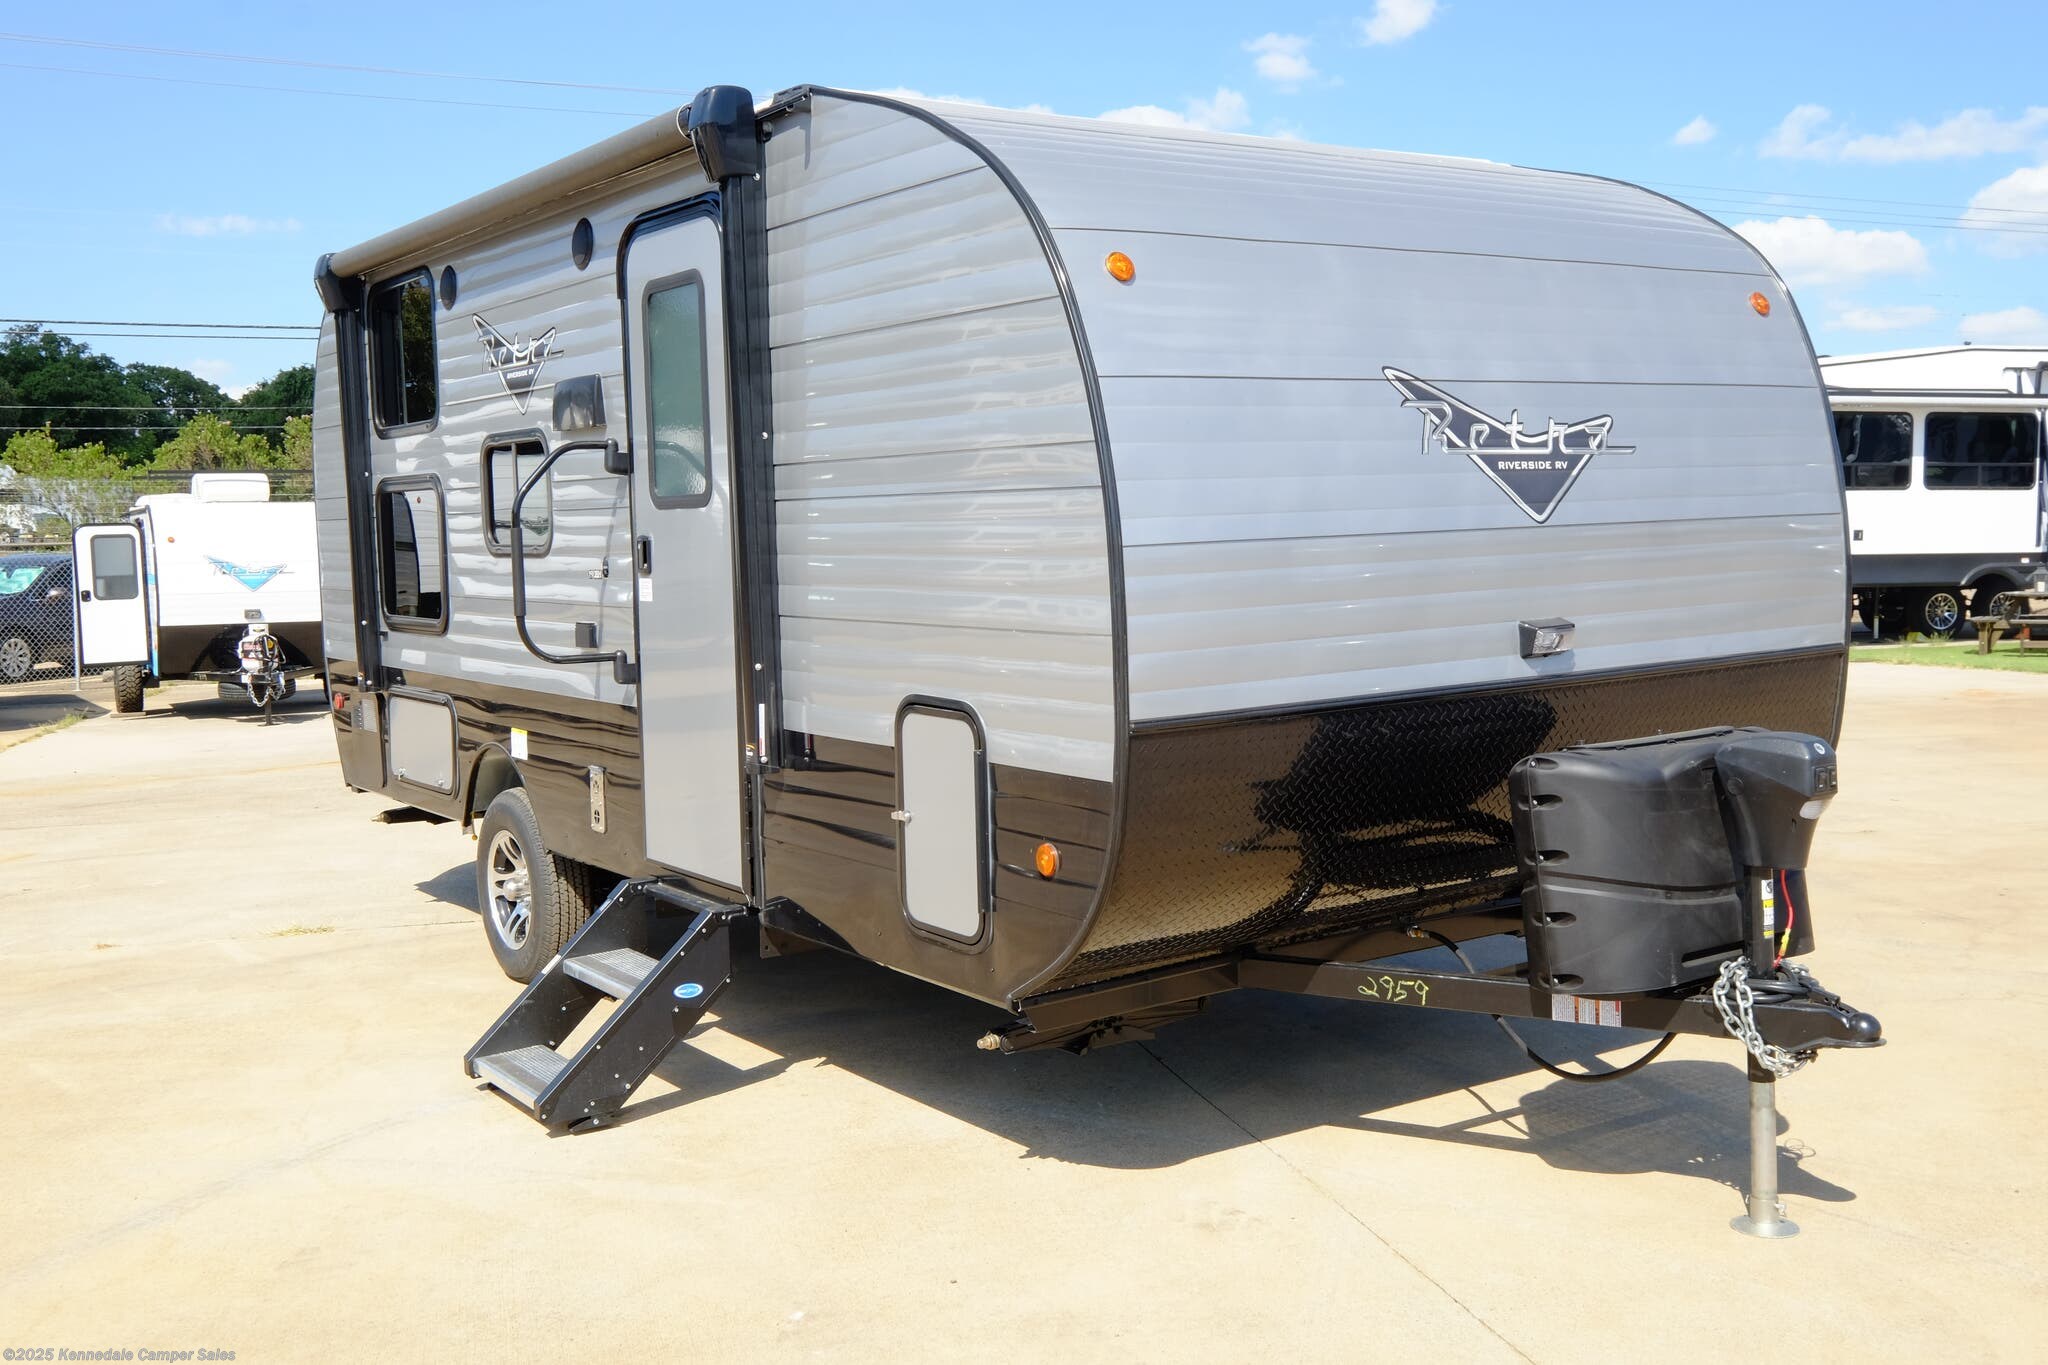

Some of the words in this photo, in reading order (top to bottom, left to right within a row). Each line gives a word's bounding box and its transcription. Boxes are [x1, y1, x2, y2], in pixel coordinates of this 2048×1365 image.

[1401, 400, 1637, 454] Retro
[1498, 461, 1552, 470] RIVERSIDE
[1555, 461, 1568, 470] RV
[1357, 976, 1430, 1006] 2959
